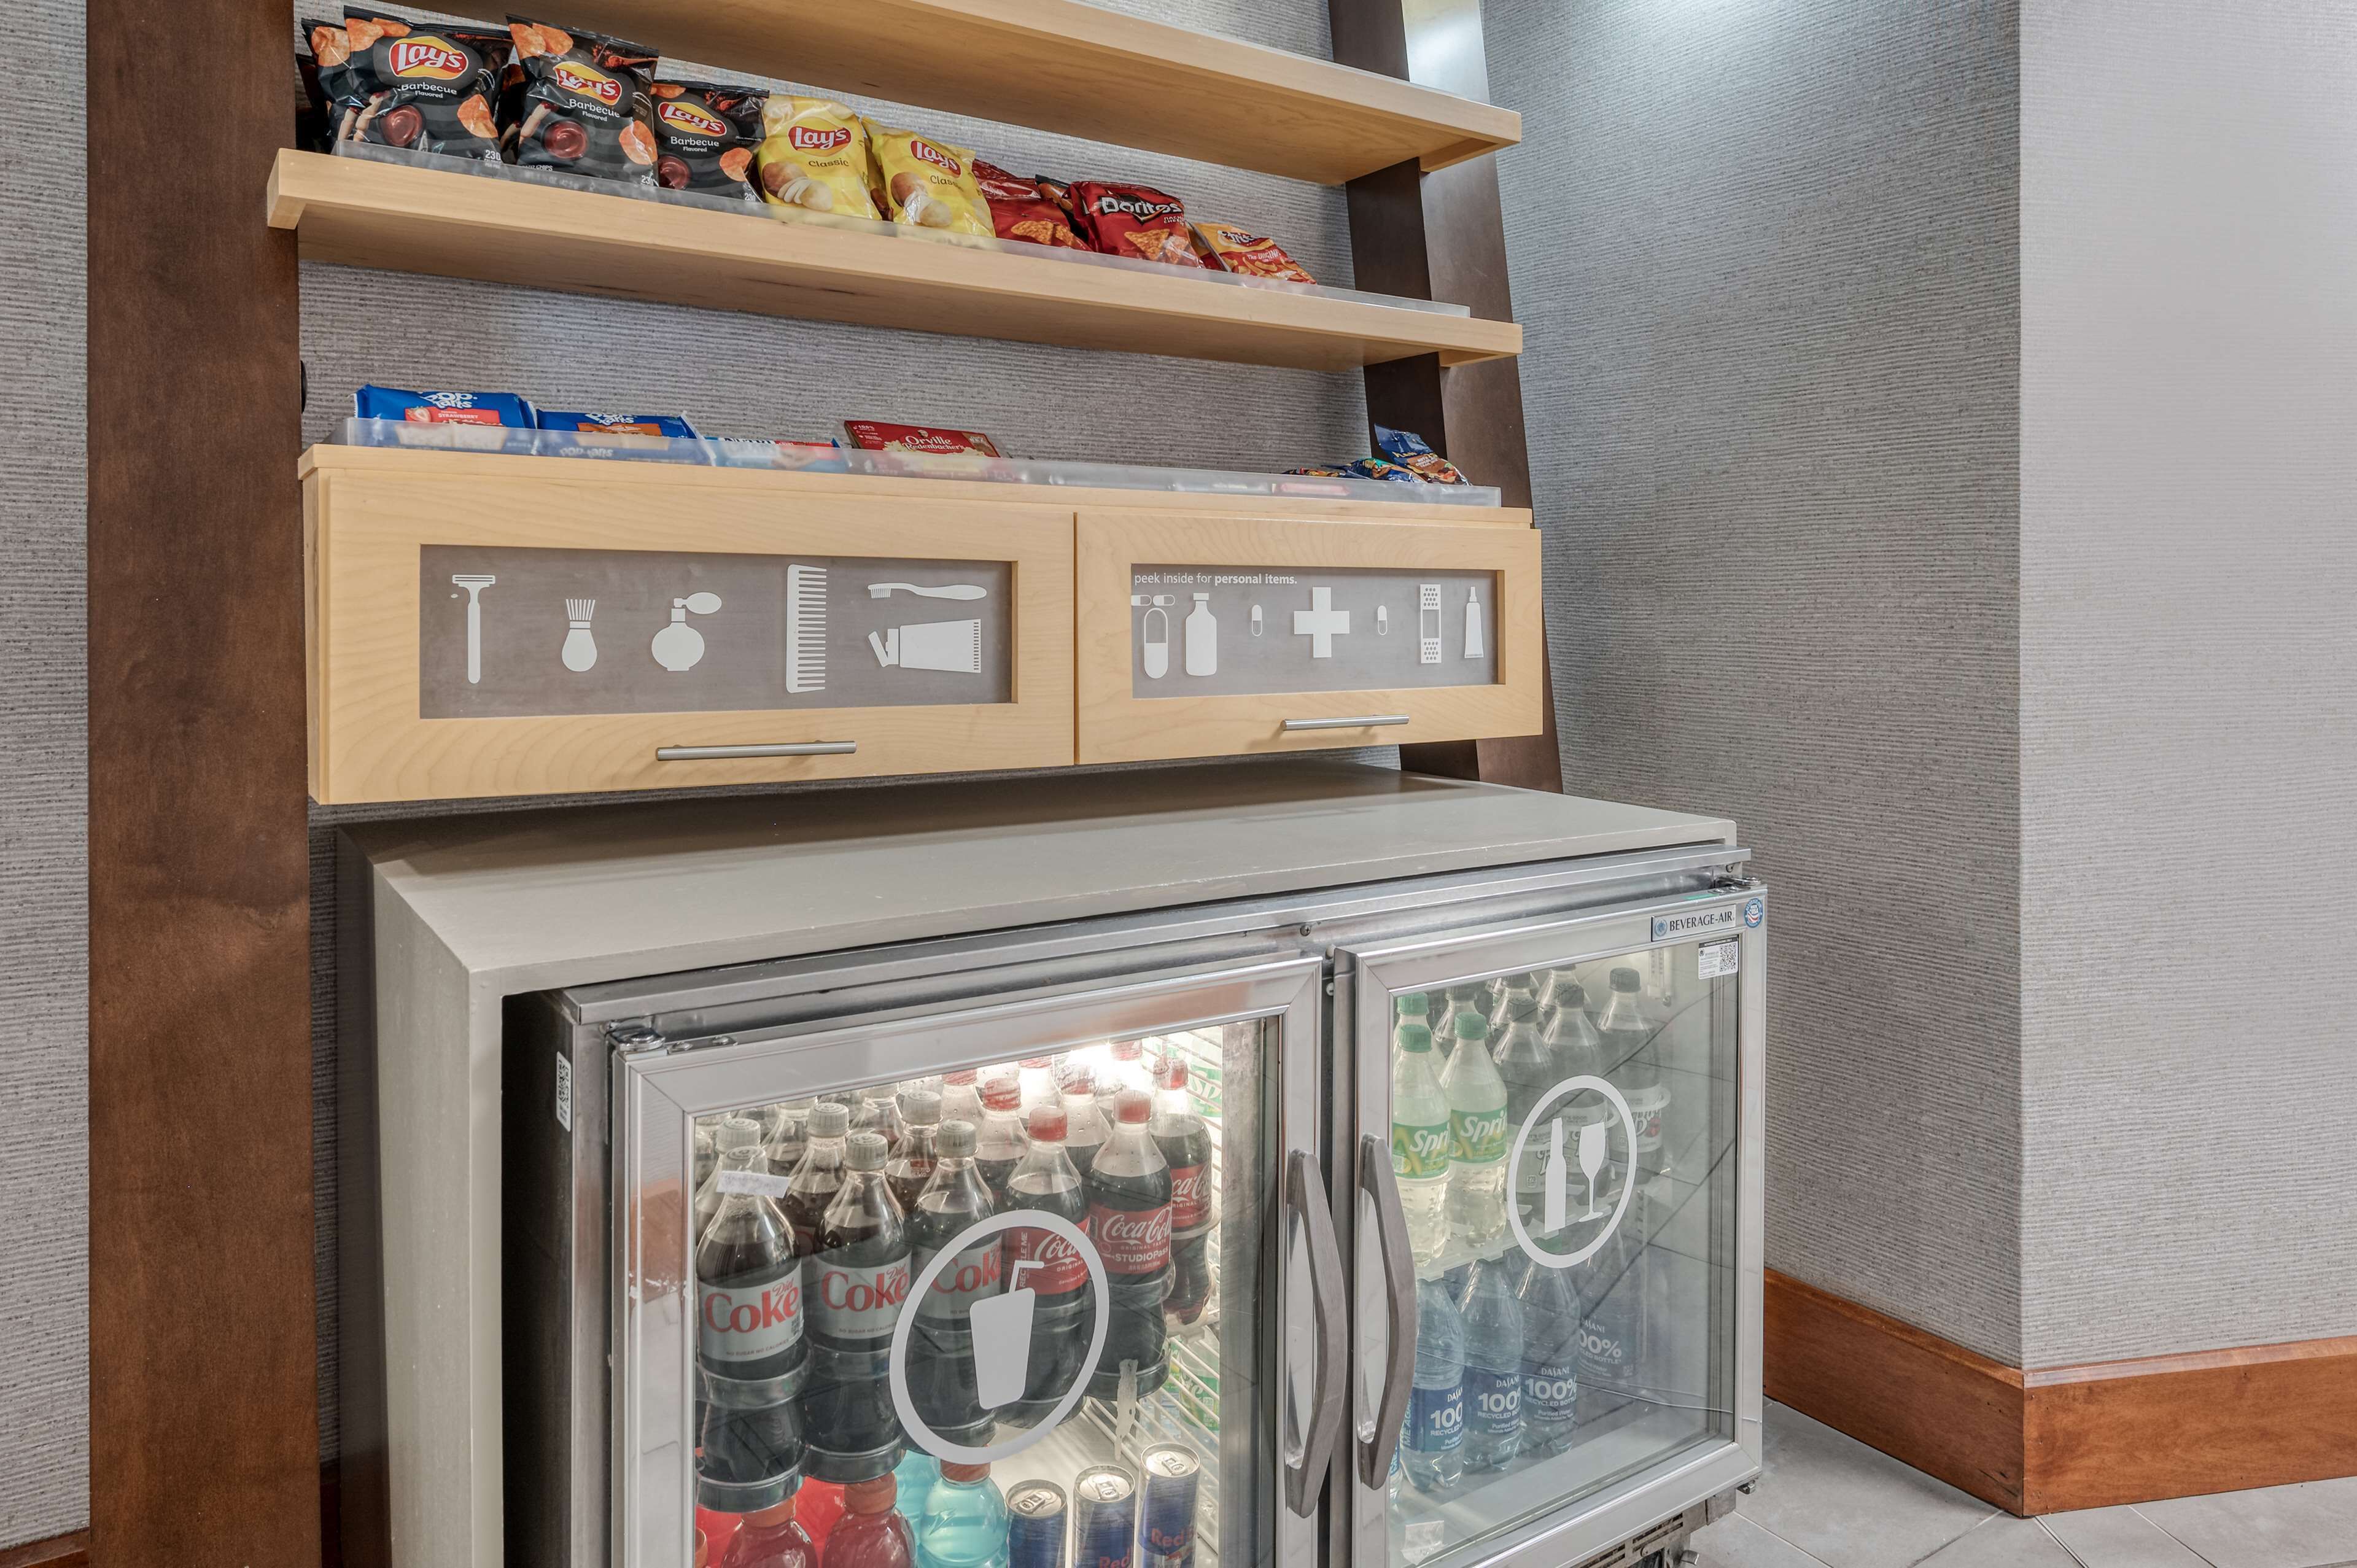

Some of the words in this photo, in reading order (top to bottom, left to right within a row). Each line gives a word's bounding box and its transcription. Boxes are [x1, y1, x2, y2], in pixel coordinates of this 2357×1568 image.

[397, 44, 463, 71] Lay's
[401, 82, 457, 95] Barbecue
[415, 90, 443, 99] Flavored
[569, 98, 620, 118] Barbecue
[582, 111, 608, 122] Flavored
[664, 105, 722, 131] Lay's
[670, 136, 720, 147] Barbecue
[794, 127, 847, 150] Lay's
[485, 149, 501, 161] 230
[808, 157, 850, 168] Classic
[1101, 196, 1182, 215] Doritos
[905, 432, 952, 445] Orville
[902, 442, 965, 451] Redenbacher's
[1134, 572, 1160, 586] peek
[1163, 572, 1194, 584] inside
[1197, 572, 1212, 584] for
[1214, 573, 1262, 586] personal
[1265, 573, 1297, 584] items.
[1669, 910, 1733, 931] BEVERAGE-AIR
[821, 1271, 909, 1313] Coke
[704, 1286, 799, 1333] Coke
[1579, 1329, 1622, 1358] 00%
[1541, 1366, 1570, 1378] DASANI
[1525, 1375, 1577, 1400] 100%
[1524, 1395, 1559, 1407] RECYCLED
[1477, 1410, 1511, 1419] RECYCLED
[1430, 1424, 1460, 1436] RECYCLED
[1151, 1527, 1184, 1548] Red
